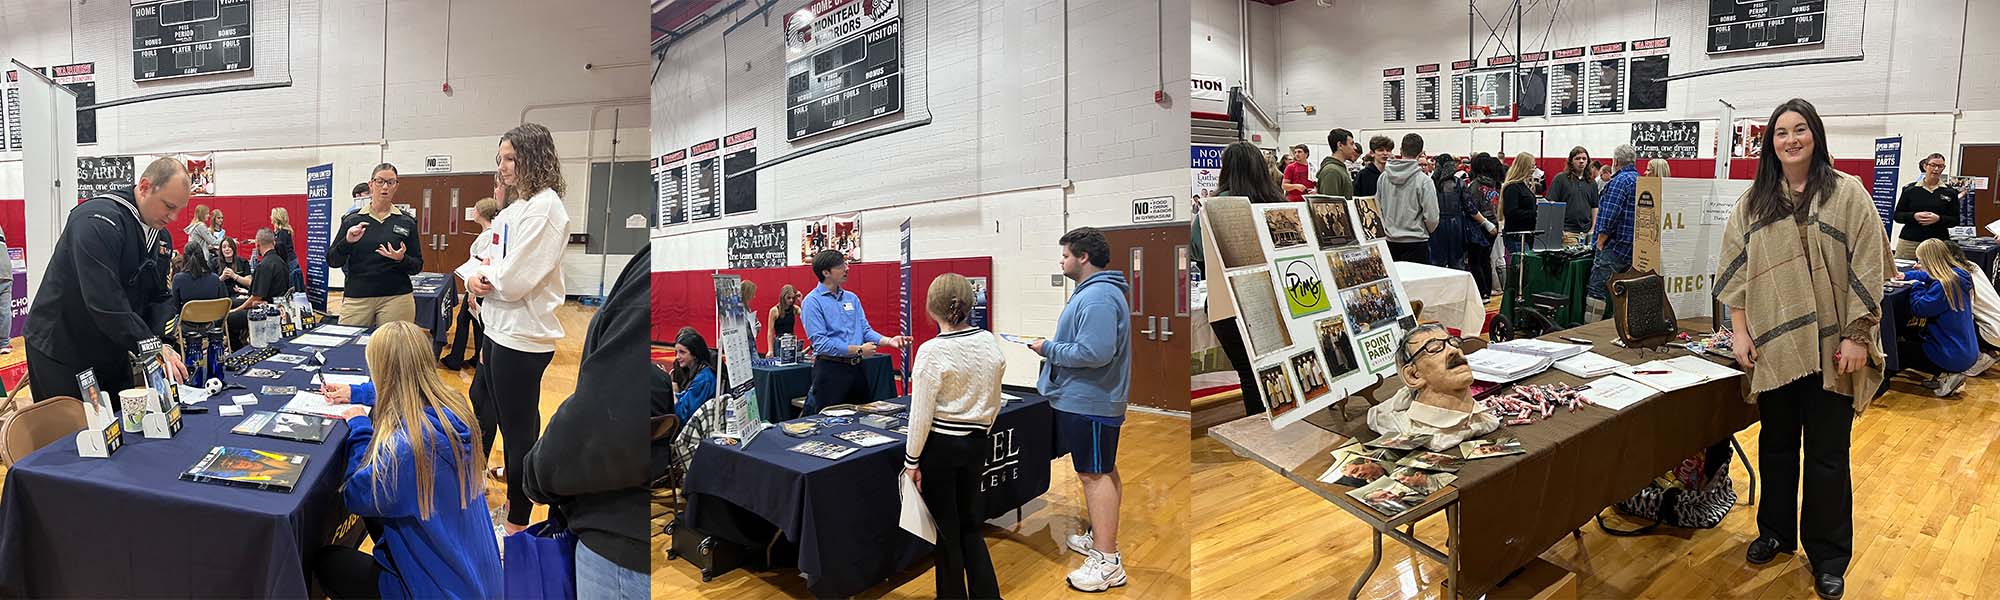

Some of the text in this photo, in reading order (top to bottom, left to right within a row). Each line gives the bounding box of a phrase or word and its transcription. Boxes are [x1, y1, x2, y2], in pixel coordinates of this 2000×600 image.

[135, 6, 156, 17] HOME
[1748, 7, 1768, 15] PERIOD
[1791, 5, 1810, 13] BONUS
[814, 2, 860, 32] MONITEAU
[1795, 15, 1813, 23] FOULS
[1745, 18, 1785, 29] PLAYER FOULS
[174, 29, 194, 38] PERIOD
[218, 28, 237, 37] BONUS
[867, 23, 898, 43] VISITOR
[144, 38, 162, 46] BONUS
[222, 39, 240, 48] FOULS
[141, 49, 157, 57] FOULS
[171, 43, 212, 54] PLAYER FOULS
[866, 67, 885, 80] BONUS
[870, 79, 888, 91] FOULS
[1191, 79, 1223, 91] TION
[822, 94, 840, 106] PLAYER
[843, 88, 860, 100] FOULS
[794, 105, 808, 115] FOULS
[1635, 129, 1691, 142] ABS ARMY
[427, 158, 436, 167] NO
[1193, 159, 1223, 168] HIRI
[1876, 158, 1895, 166] PARTS
[91, 166, 125, 180] ARMY
[1197, 174, 1219, 182] Luthe
[1197, 180, 1218, 188] Senio
[309, 188, 328, 198] PARTS
[1135, 202, 1148, 215] NO
[1663, 212, 1685, 230] AL
[751, 232, 780, 248] ARMY
[11, 297, 28, 308] CHO
[141, 340, 161, 352] NROTC
[1365, 334, 1392, 351] POINT
[1368, 345, 1393, 361] PARK
[984, 428, 1020, 466] EL
